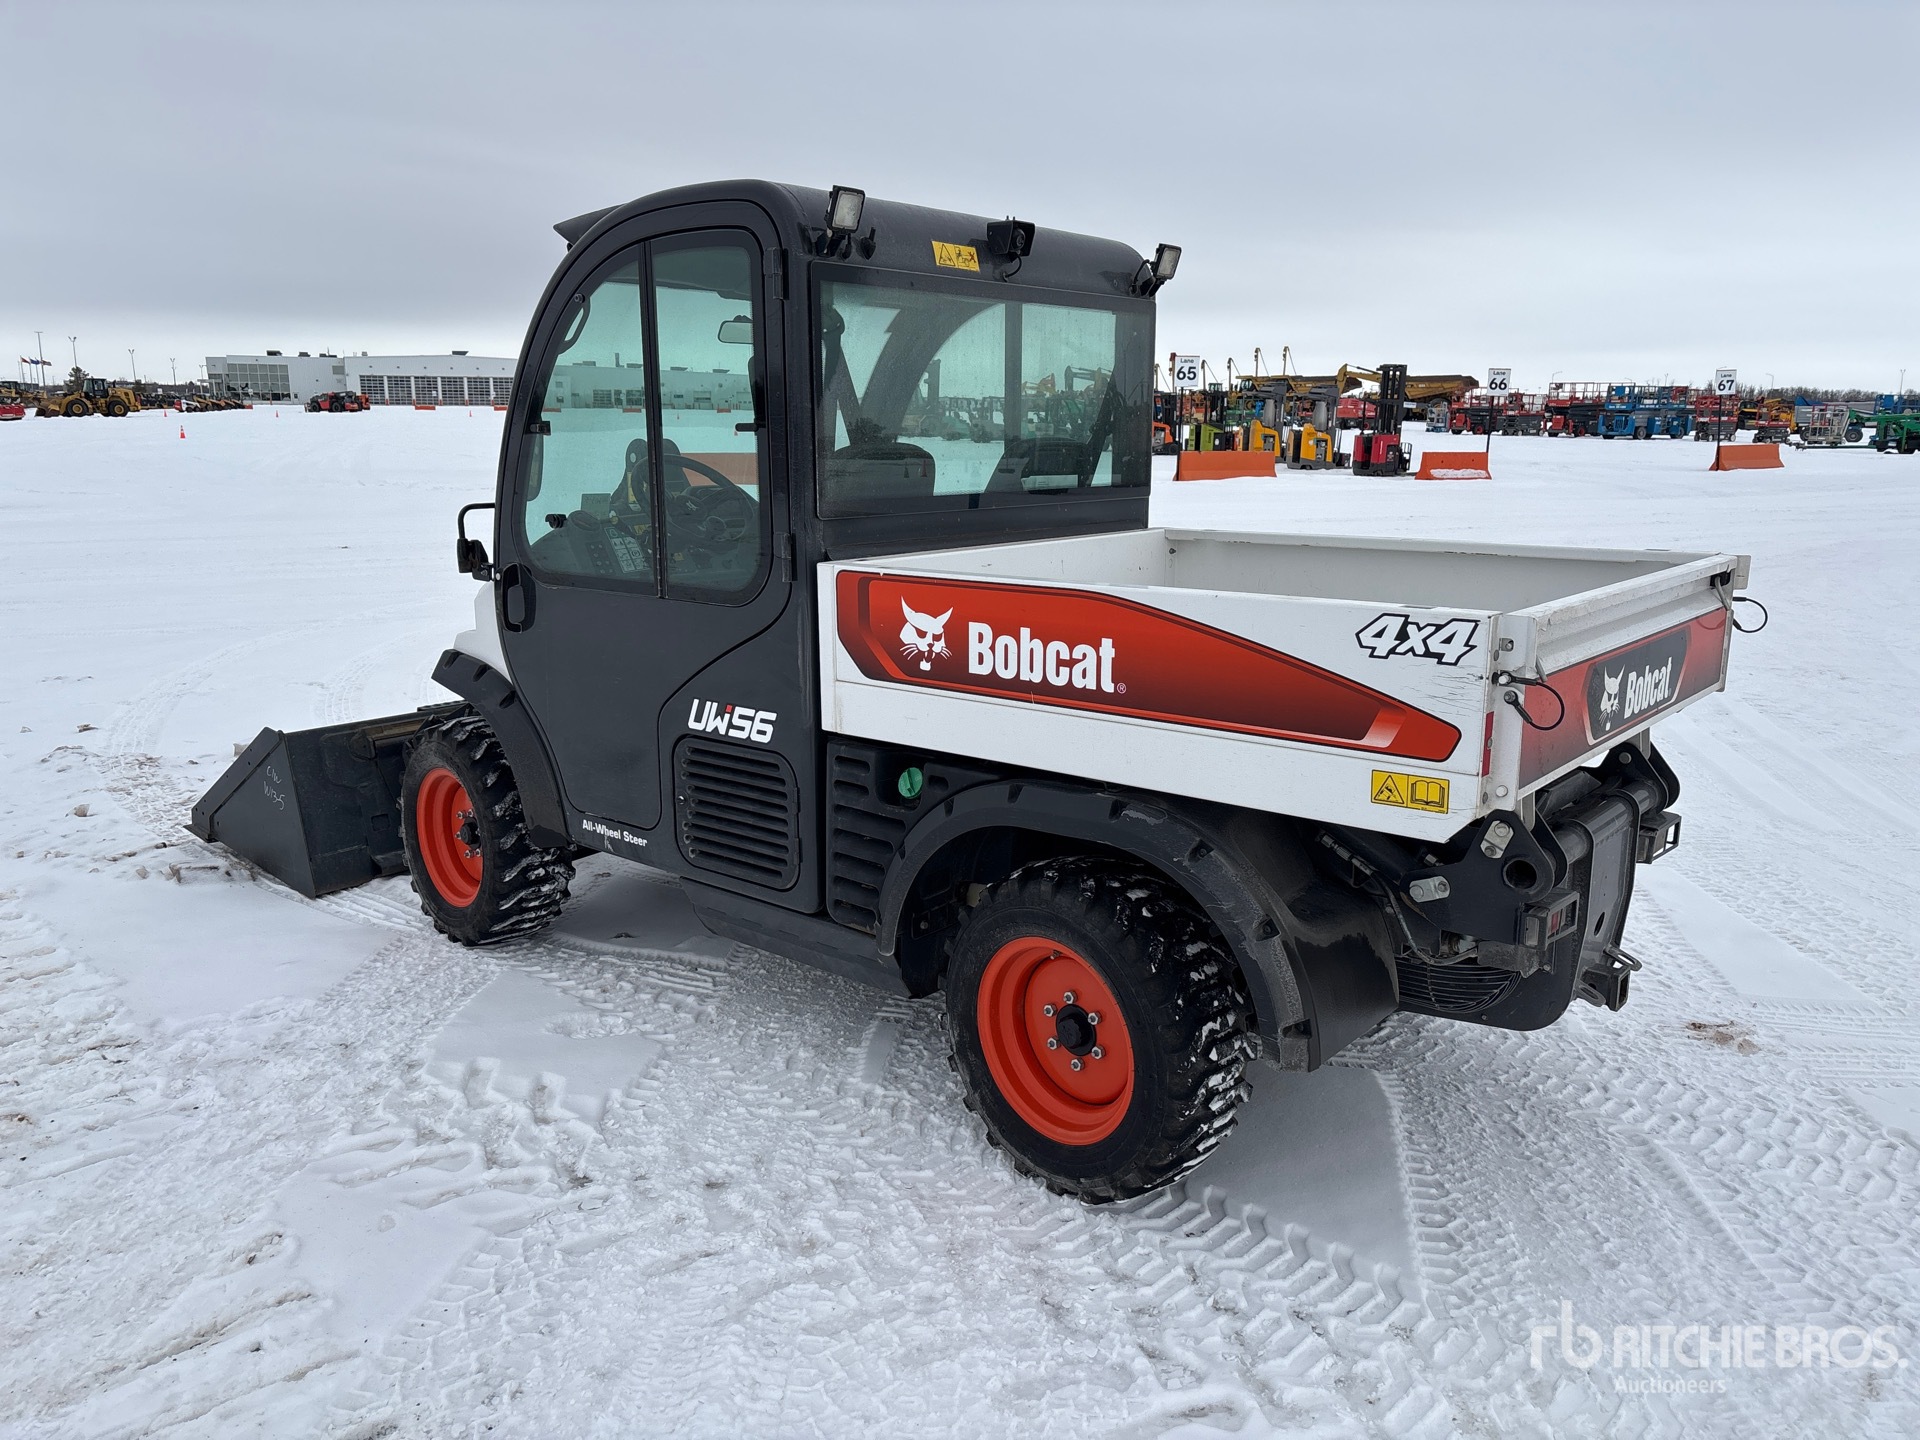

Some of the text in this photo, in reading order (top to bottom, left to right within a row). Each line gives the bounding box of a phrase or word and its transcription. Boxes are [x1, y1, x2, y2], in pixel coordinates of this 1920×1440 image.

[1176, 366, 1197, 381] 65
[1489, 378, 1507, 390] 66
[1717, 380, 1735, 391] 67
[1355, 613, 1481, 666] 4x4
[968, 621, 1115, 693] Bobcat
[1624, 656, 1673, 719] Bobcat
[582, 819, 648, 847] All-Wheel Steer
